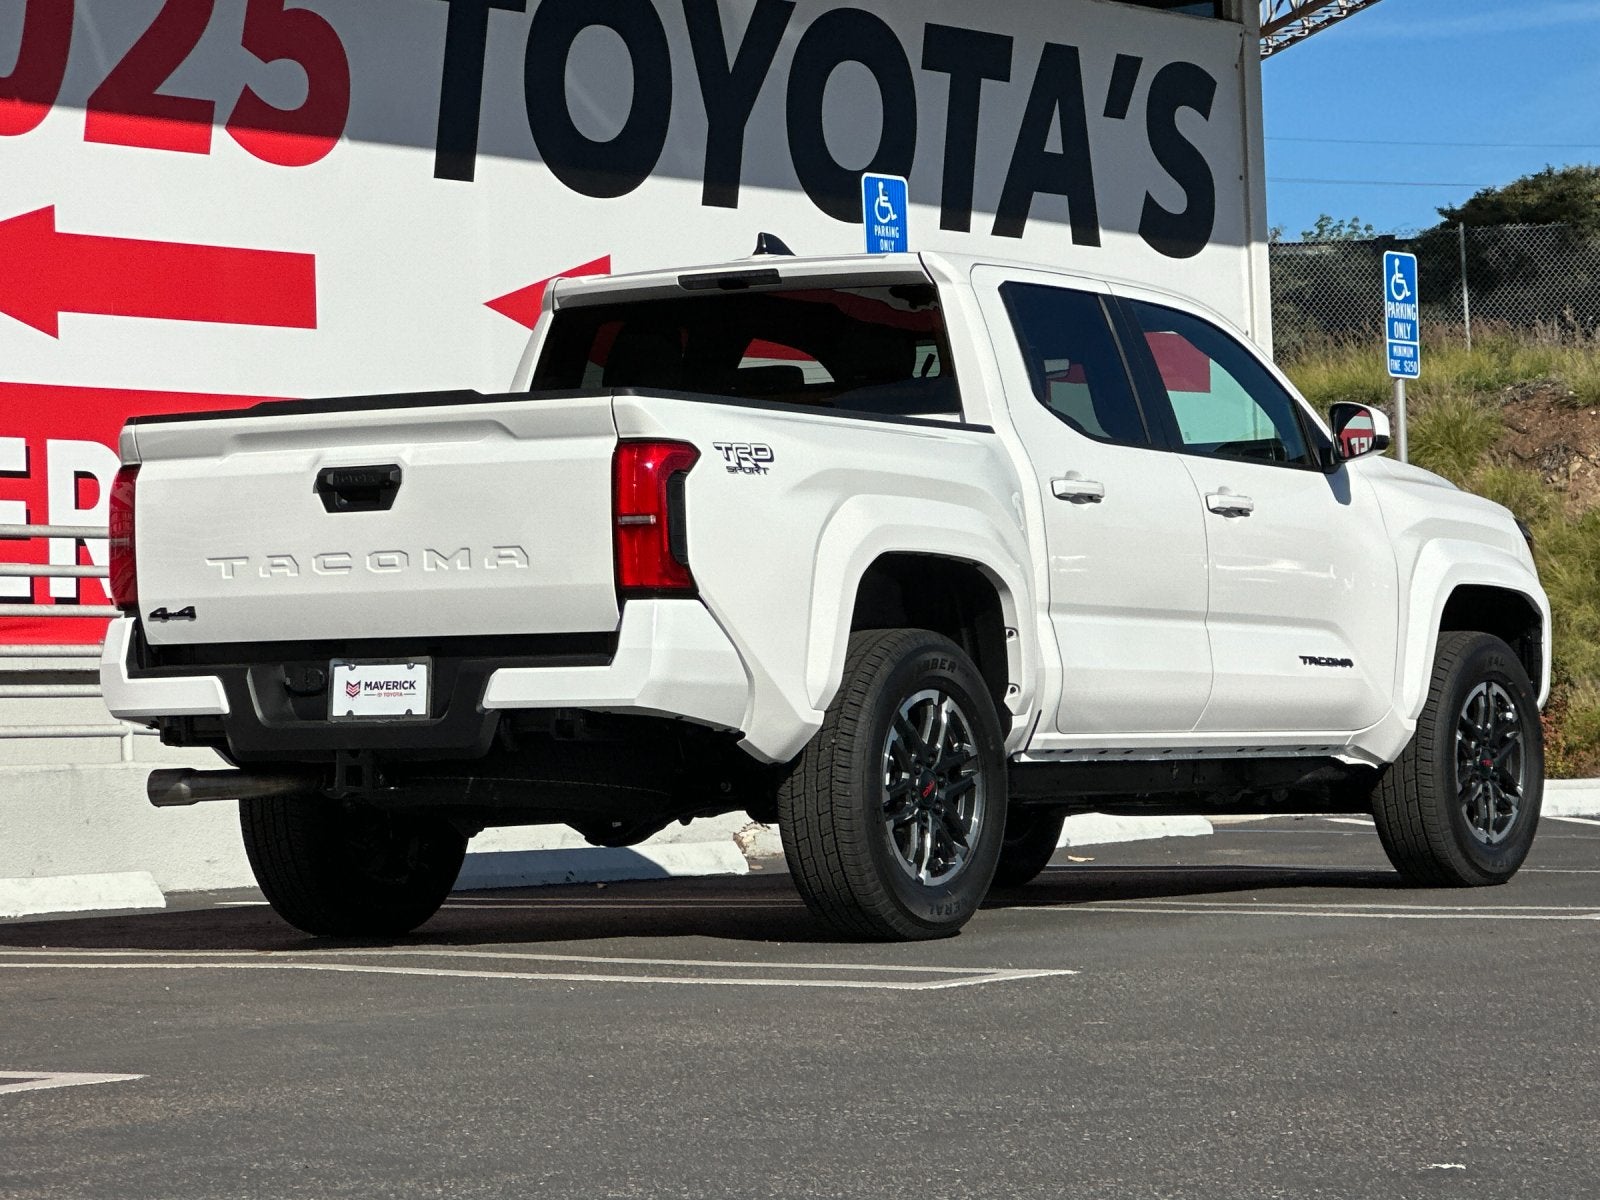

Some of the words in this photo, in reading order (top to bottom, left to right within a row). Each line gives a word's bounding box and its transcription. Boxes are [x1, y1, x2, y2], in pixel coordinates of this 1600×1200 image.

[434, 0, 1217, 258] TOYOTA'S
[874, 225, 900, 239] PARKING
[880, 239, 895, 252] ONLY
[1387, 301, 1416, 321] PARKING
[1393, 321, 1412, 340] ONLY
[1393, 345, 1414, 358] MINIMUM
[1390, 359, 1401, 372] FINE
[1403, 360, 1418, 373] $250
[712, 442, 775, 468] TRD
[726, 466, 770, 476] SPORT
[205, 545, 529, 579] TACOMA
[1298, 655, 1354, 668] TACOMA
[364, 680, 416, 690] MAVERICK
